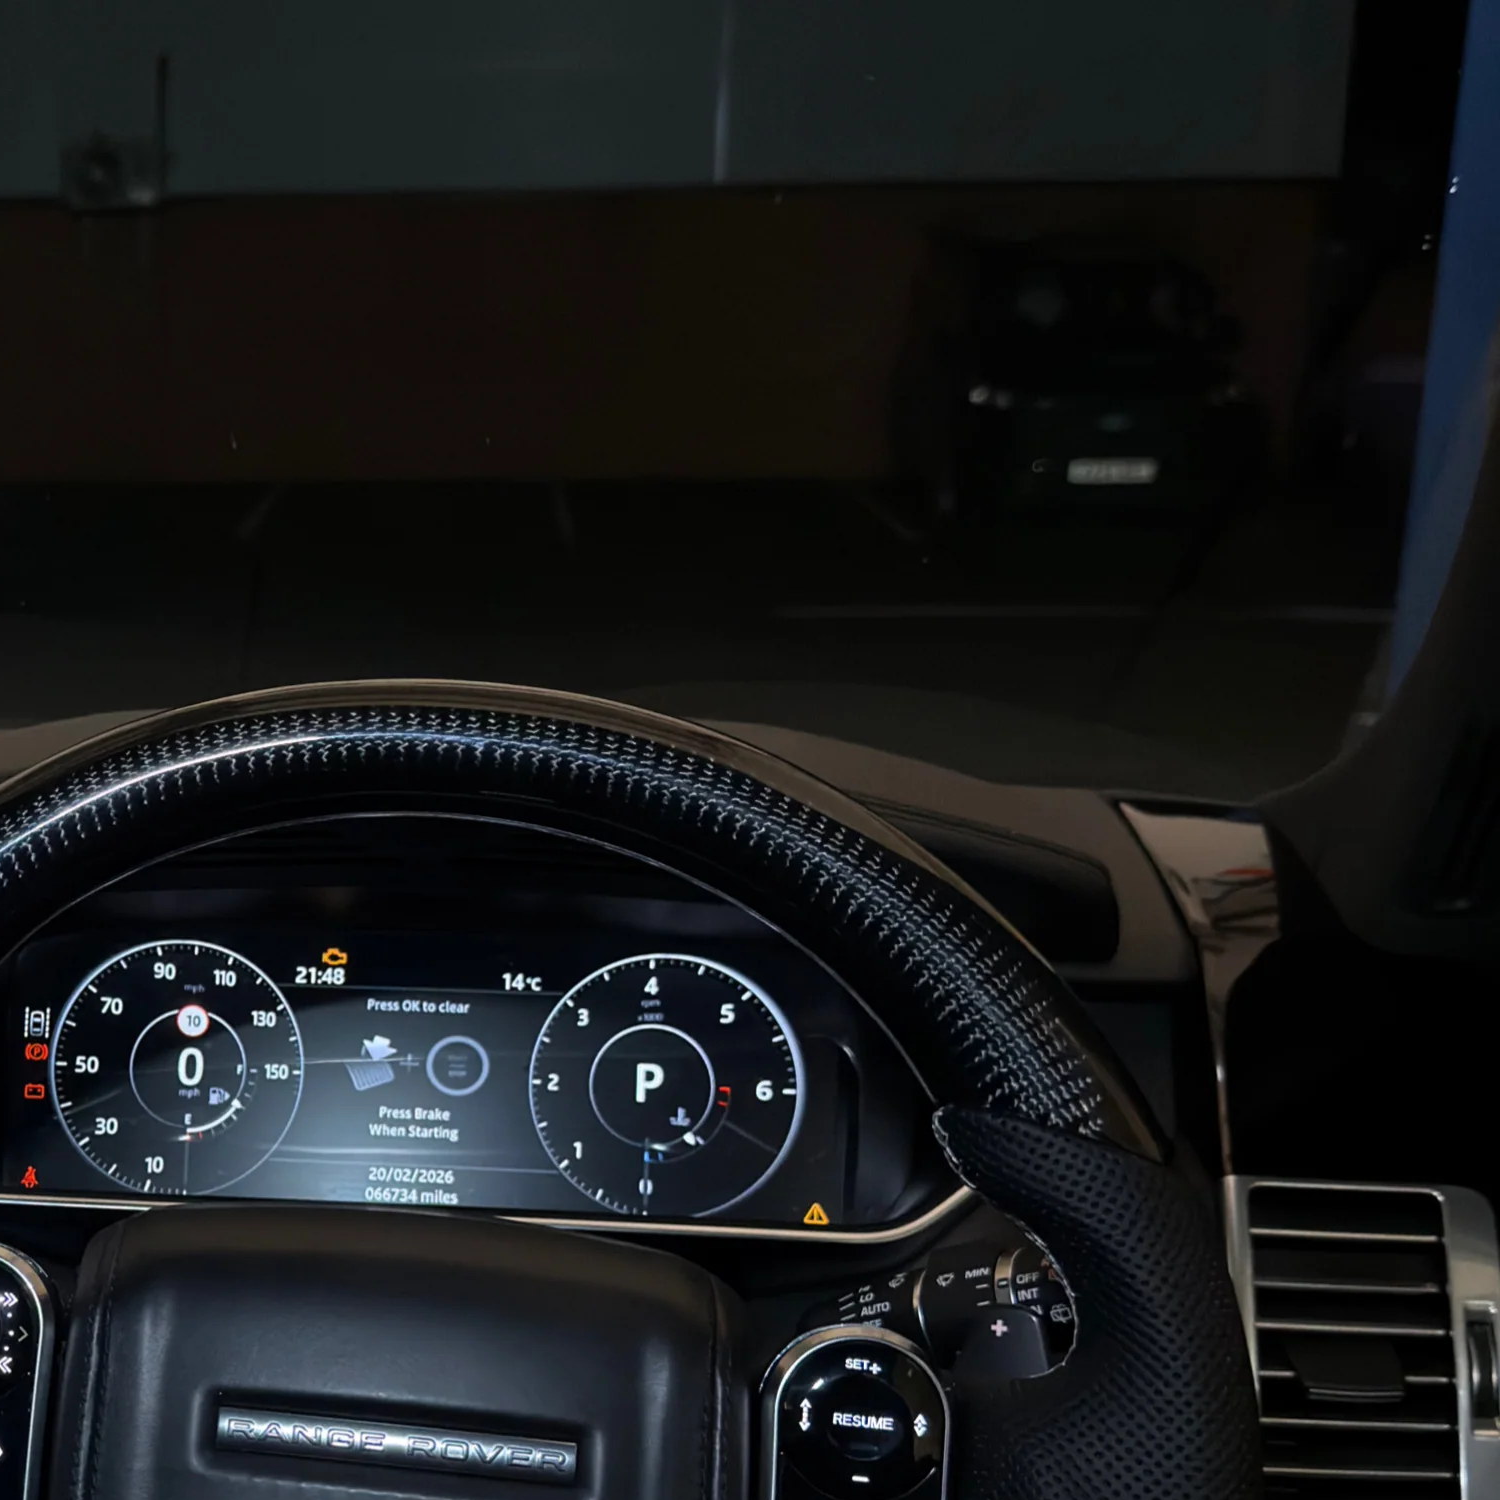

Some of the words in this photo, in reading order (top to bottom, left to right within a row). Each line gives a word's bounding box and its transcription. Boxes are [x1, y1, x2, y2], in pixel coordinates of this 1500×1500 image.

[154, 962, 176, 980] 90
[213, 969, 236, 987] 110
[295, 966, 345, 986] 21:48
[644, 976, 659, 995] 4
[100, 997, 123, 1015] 70
[367, 998, 399, 1012] Press
[402, 1000, 420, 1012] OK
[422, 1001, 436, 1013] to
[438, 1002, 470, 1014] clear
[719, 1003, 736, 1024] 5
[186, 1014, 200, 1027] 10
[251, 1010, 276, 1027] 130
[577, 1009, 590, 1027] 3
[75, 1056, 99, 1073] 50
[178, 1047, 204, 1086] 0
[264, 1064, 289, 1080] 150
[547, 1074, 560, 1092] 2
[635, 1063, 665, 1103] P
[755, 1080, 774, 1101] 6
[184, 1113, 192, 1125] E
[379, 1105, 411, 1120] Press
[414, 1107, 451, 1121] Brake
[95, 1118, 118, 1135] 30
[369, 1124, 406, 1137] When
[408, 1125, 459, 1141] Starting
[573, 1142, 583, 1159] 1
[145, 1157, 164, 1174] 10
[368, 1167, 455, 1184] 20/02/2026
[638, 1179, 653, 1194] 0
[365, 1187, 417, 1203] 066734
[420, 1188, 458, 1205] miles
[965, 1267, 990, 1279] MIN
[1016, 1271, 1040, 1284] OFF
[1017, 1287, 1039, 1301] INT
[860, 1302, 891, 1317] AUTO
[832, 1413, 894, 1431] RESUME
[226, 1417, 386, 1453] RANGE
[407, 1435, 568, 1472] ROVER
